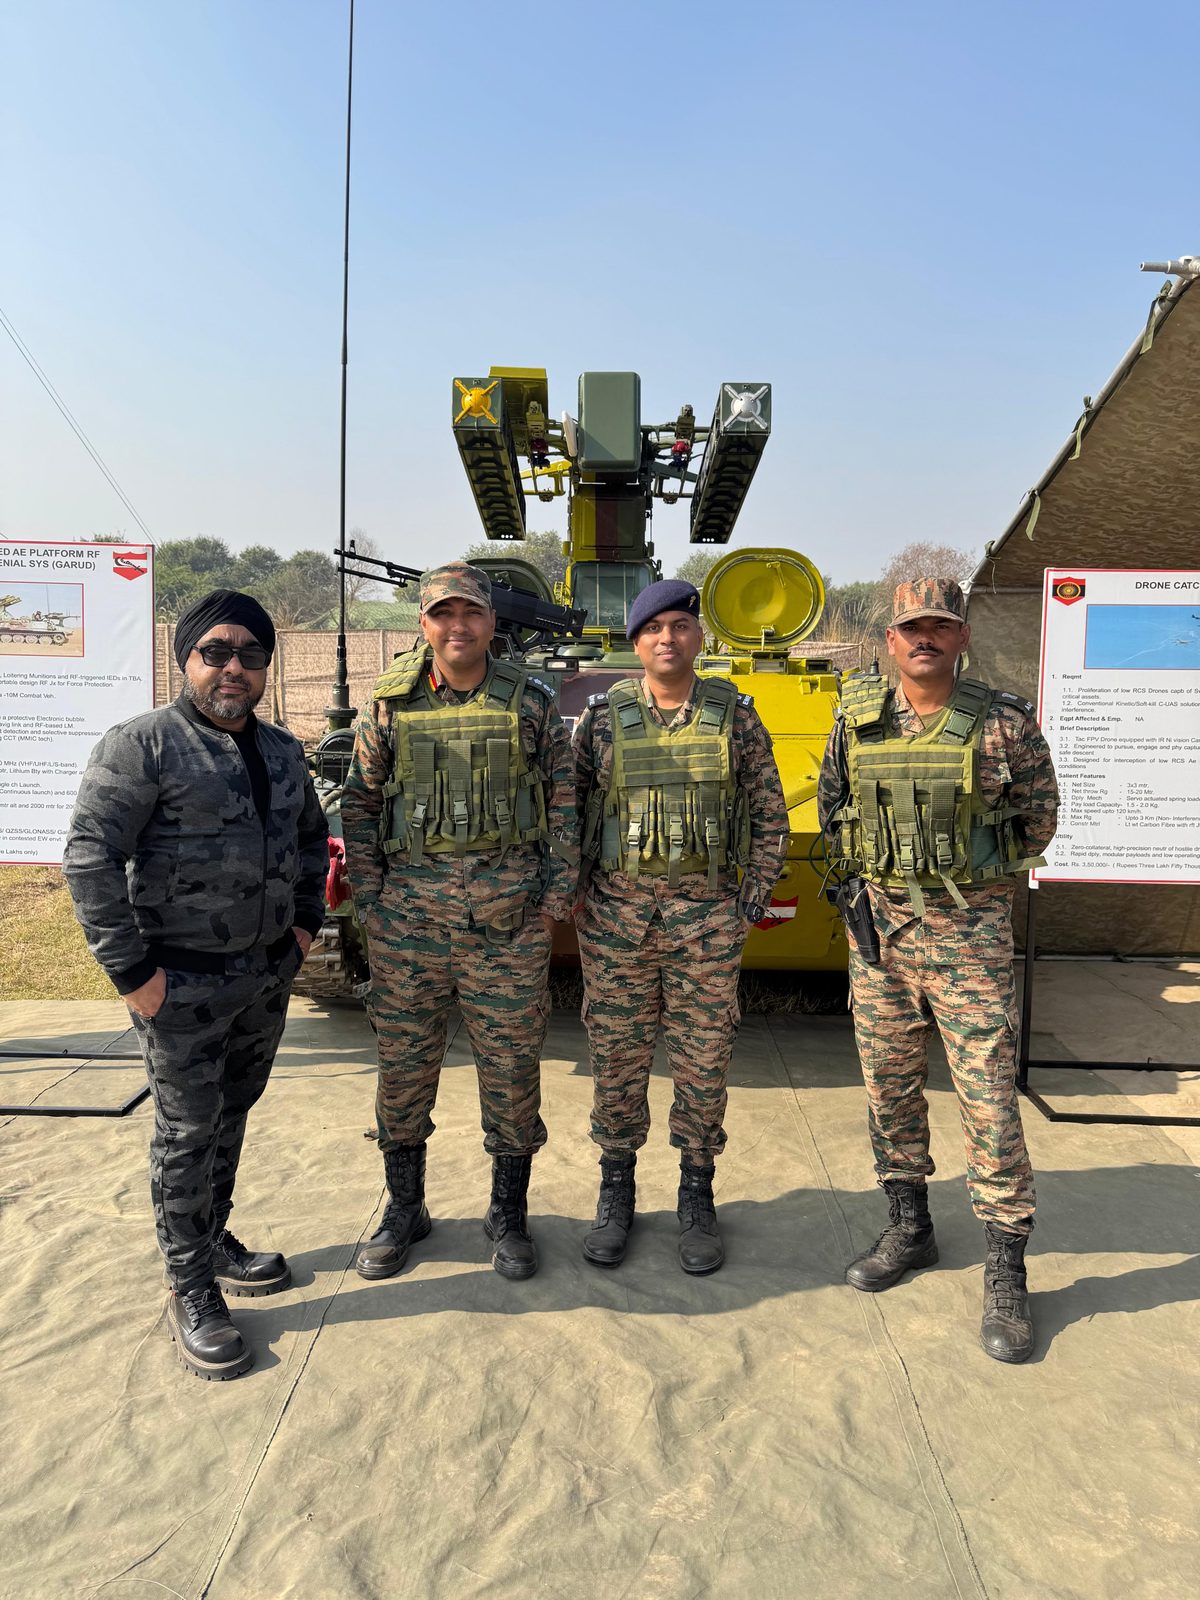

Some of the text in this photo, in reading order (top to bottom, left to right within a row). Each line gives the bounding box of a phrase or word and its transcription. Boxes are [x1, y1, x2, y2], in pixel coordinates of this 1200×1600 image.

[30, 549, 84, 558] PLATFORM
[52, 560, 96, 571] (GARUD)
[1135, 581, 1200, 590] DRONE CATC
